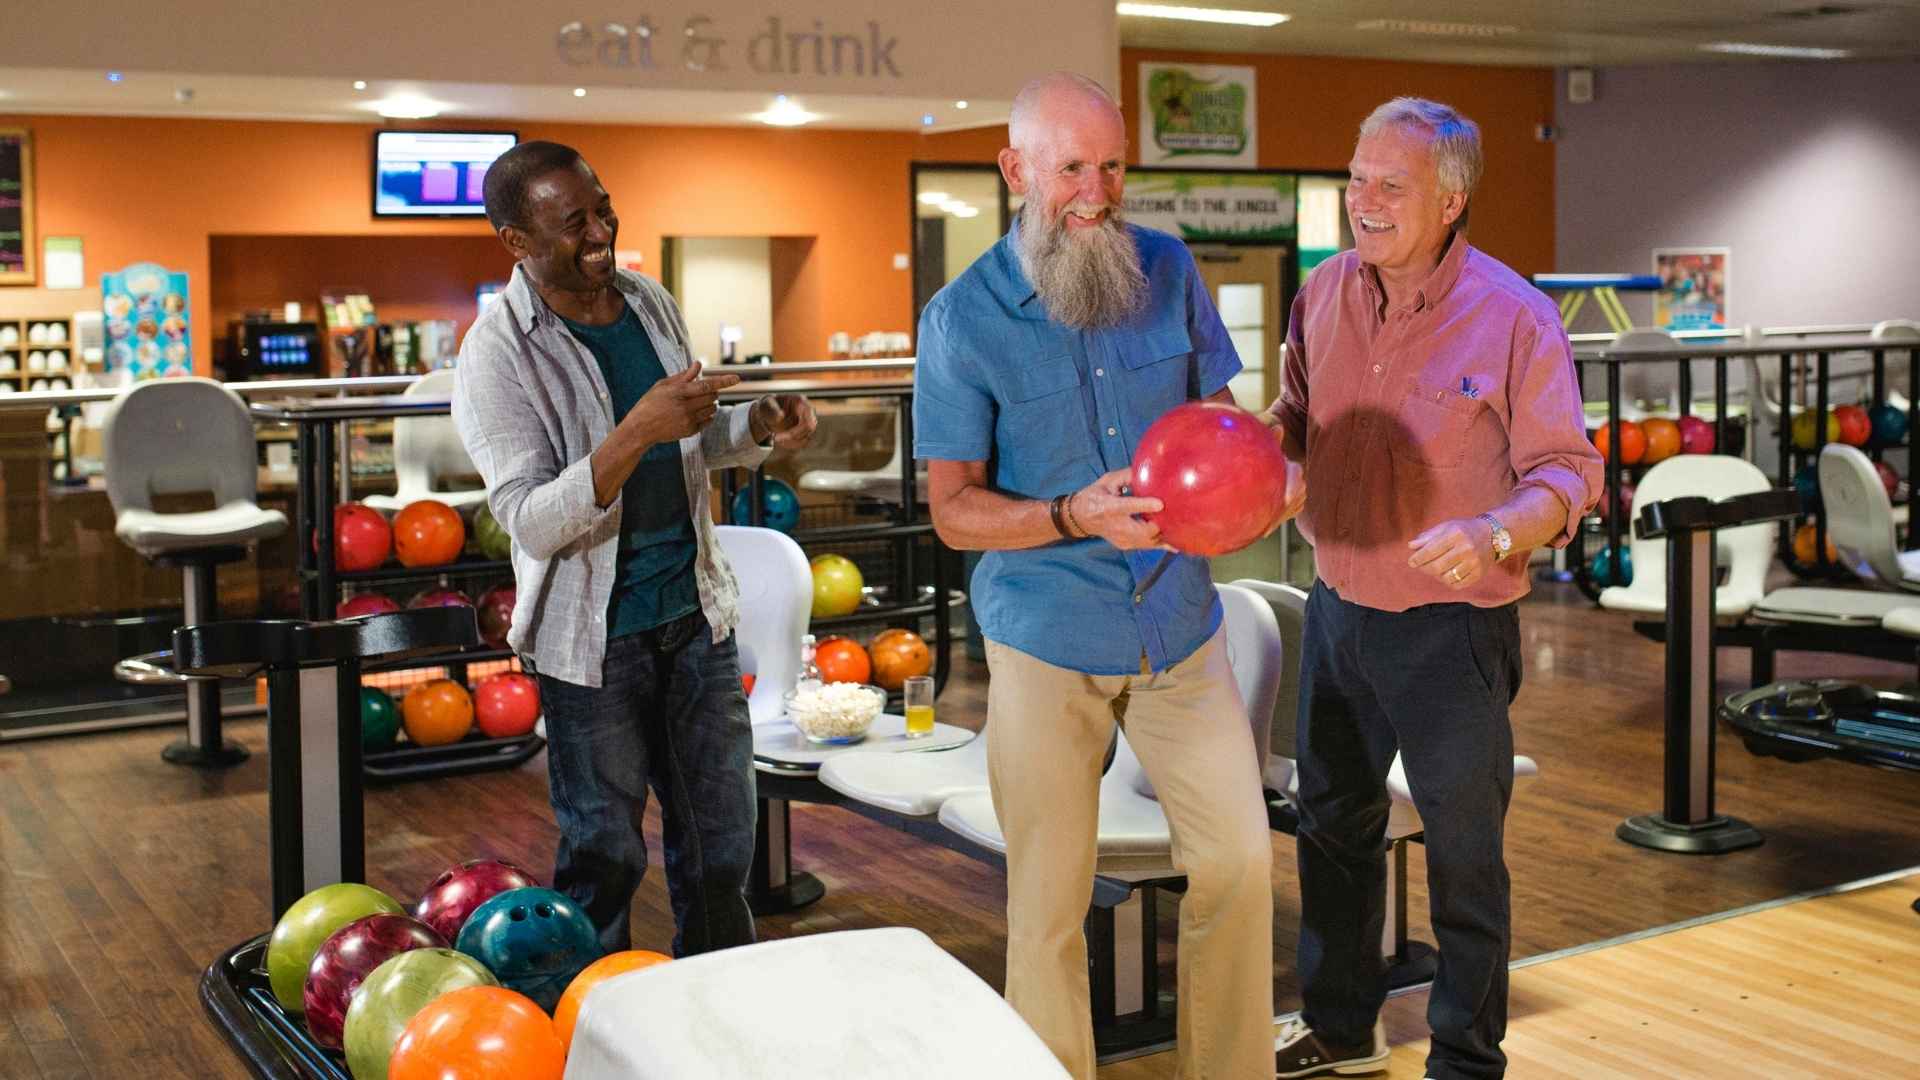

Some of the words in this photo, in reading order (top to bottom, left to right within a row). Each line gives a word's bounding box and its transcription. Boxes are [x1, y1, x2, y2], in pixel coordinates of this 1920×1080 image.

[556, 15, 658, 70] eat
[681, 14, 729, 72] &
[746, 16, 902, 78] drink
[1182, 198, 1201, 213] TO
[1203, 198, 1226, 213] THE
